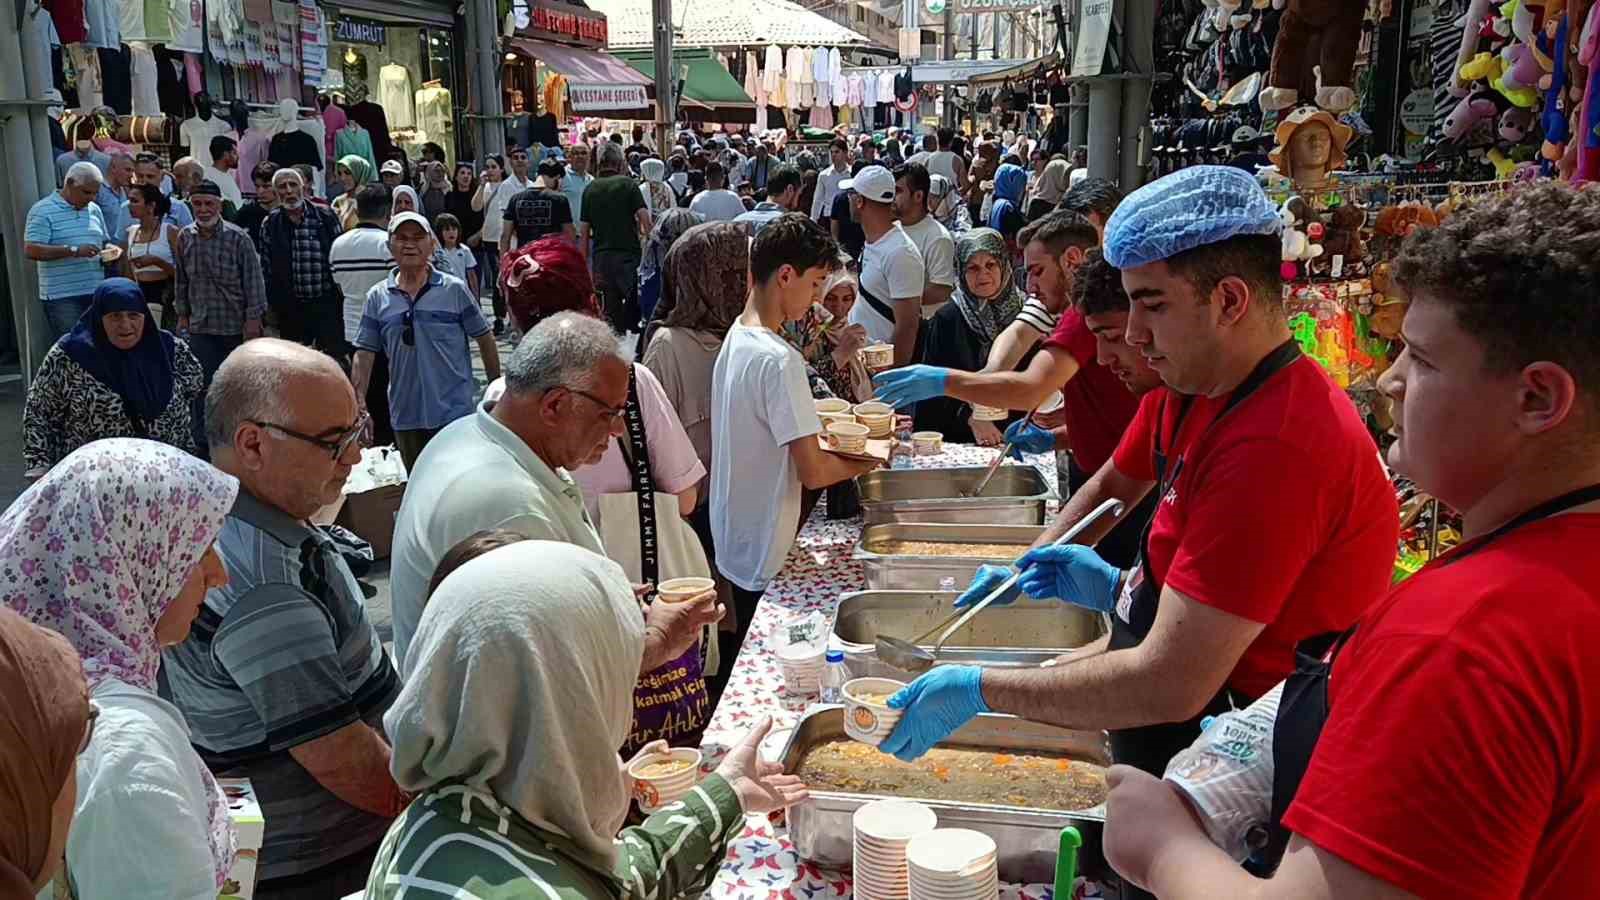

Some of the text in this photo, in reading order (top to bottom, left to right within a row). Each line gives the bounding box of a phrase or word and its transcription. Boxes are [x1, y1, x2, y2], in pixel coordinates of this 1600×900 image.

[336, 17, 384, 43] ZÜMRÜT
[626, 401, 651, 509] JIMMY FAIRLY
[644, 515, 654, 566] JIMMY
[635, 686, 684, 709] katmak
